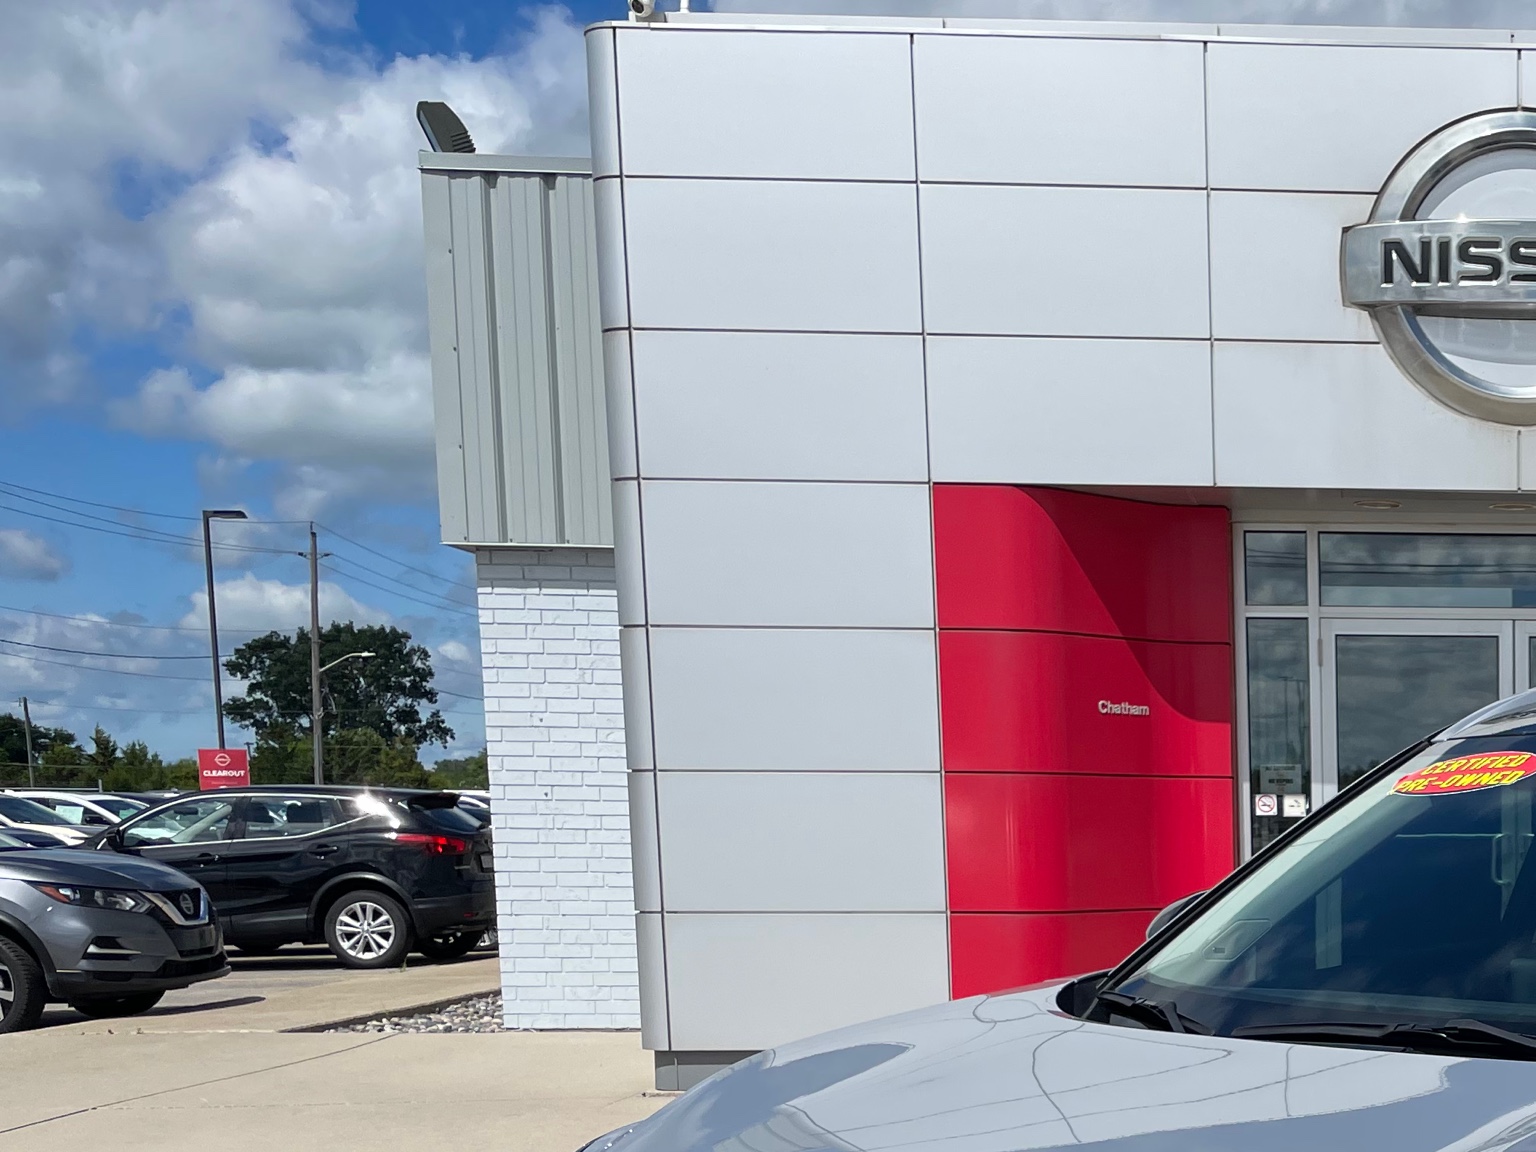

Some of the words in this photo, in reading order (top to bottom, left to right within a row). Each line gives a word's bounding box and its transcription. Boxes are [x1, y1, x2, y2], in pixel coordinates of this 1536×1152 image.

[1098, 699, 1150, 716] Chatham
[202, 769, 246, 777] CLEAROUT
[1421, 754, 1531, 775] CERTIFIED
[1390, 770, 1526, 794] PRE-OWNED
